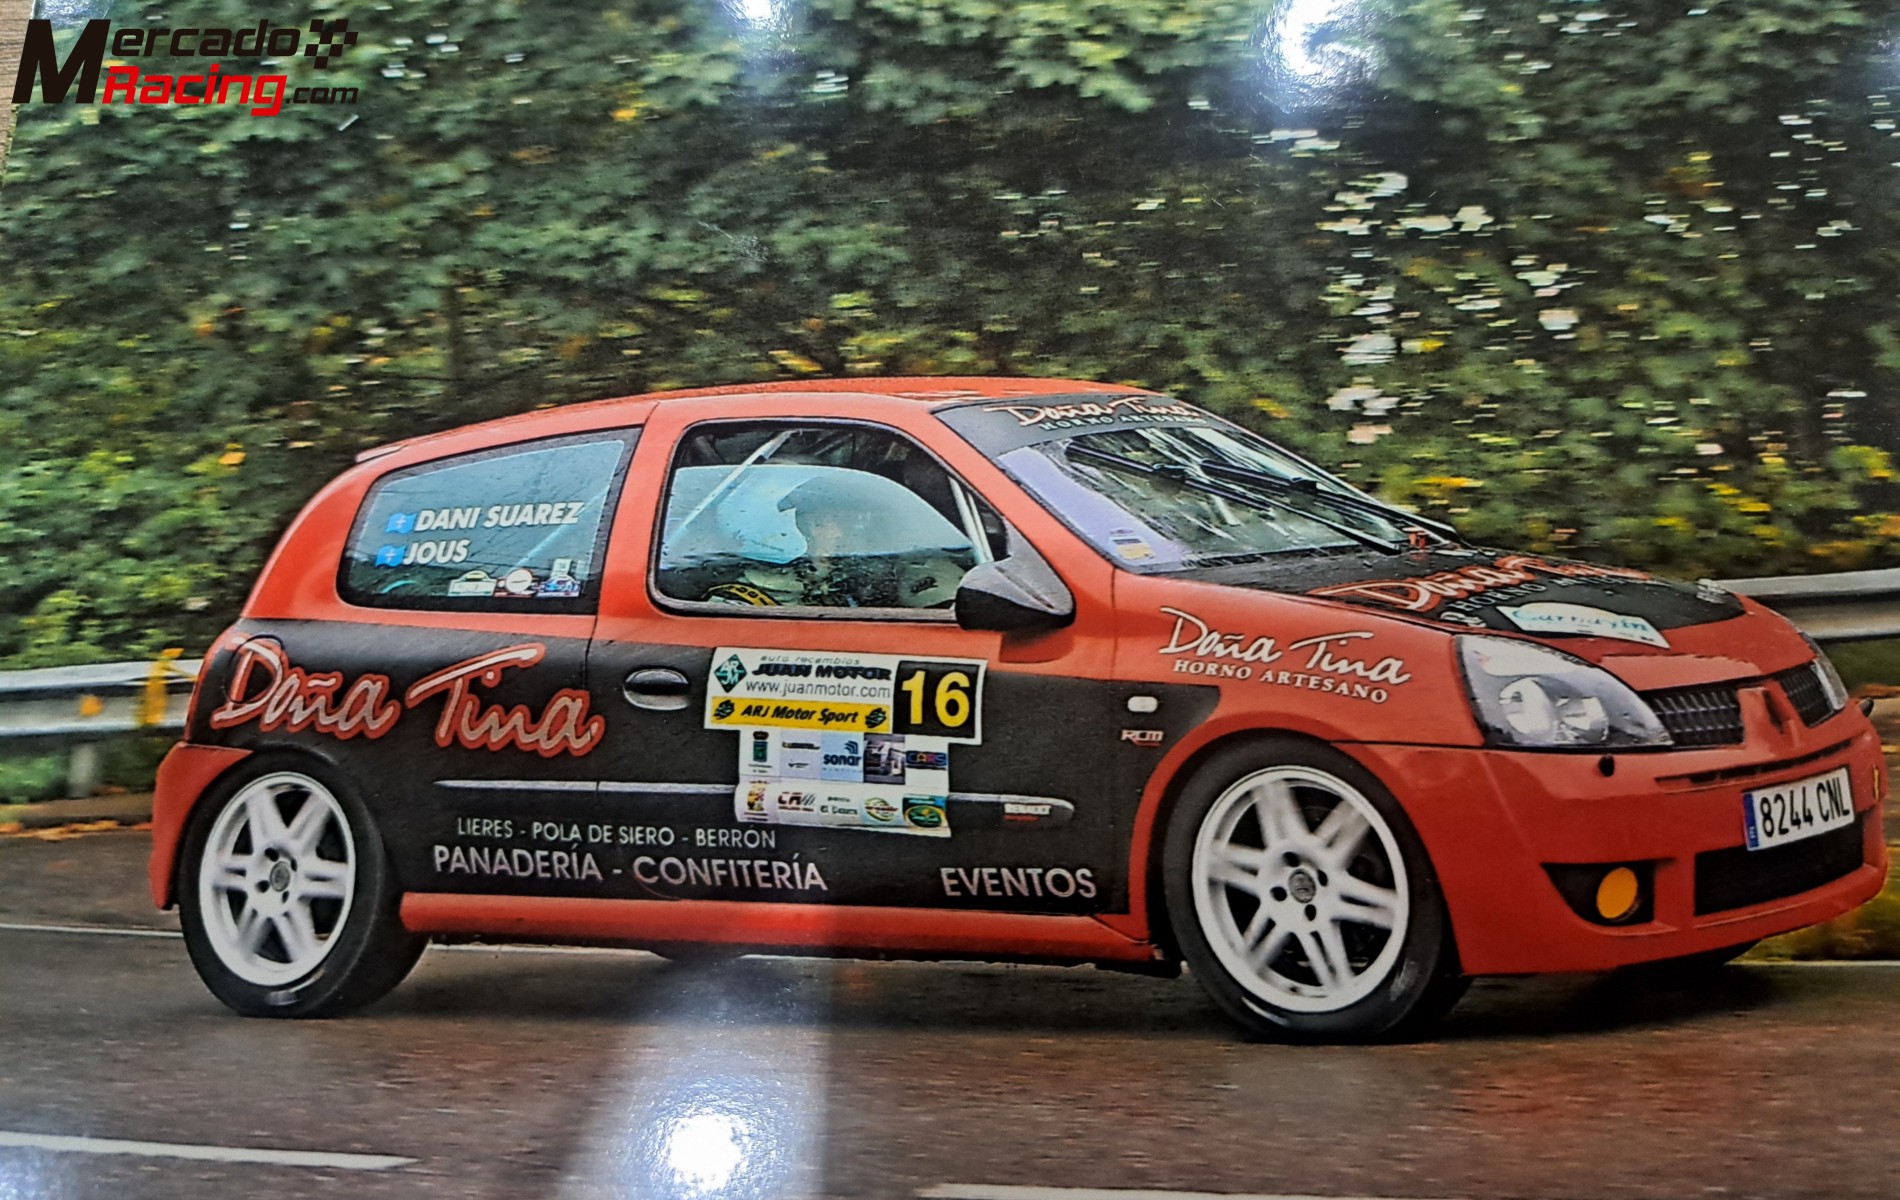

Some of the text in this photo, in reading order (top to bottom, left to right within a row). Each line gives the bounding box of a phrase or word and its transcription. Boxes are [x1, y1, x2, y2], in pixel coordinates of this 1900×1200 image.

[414, 501, 585, 532] DANI SUAREZ
[403, 539, 471, 565] JOUS
[1159, 606, 1412, 685] Doña Tina
[211, 634, 604, 756] Doña Tina
[745, 680, 891, 698] www.juanmotor.com
[1173, 658, 1389, 704] HORNO ARTESANO
[740, 704, 859, 725] ARJ Motor Sport
[902, 670, 971, 728] 16
[823, 753, 862, 767] sonar
[1760, 776, 1850, 838] 8244 CNL
[457, 817, 513, 838] LIERES
[532, 821, 582, 843] POLA
[588, 824, 613, 844] DE
[619, 826, 675, 846] SIERO
[695, 824, 776, 849] BERRÓN
[434, 843, 603, 881] PANADERÍA
[632, 853, 829, 891] CONFITERÍA
[940, 867, 1097, 898] EVENTOS
